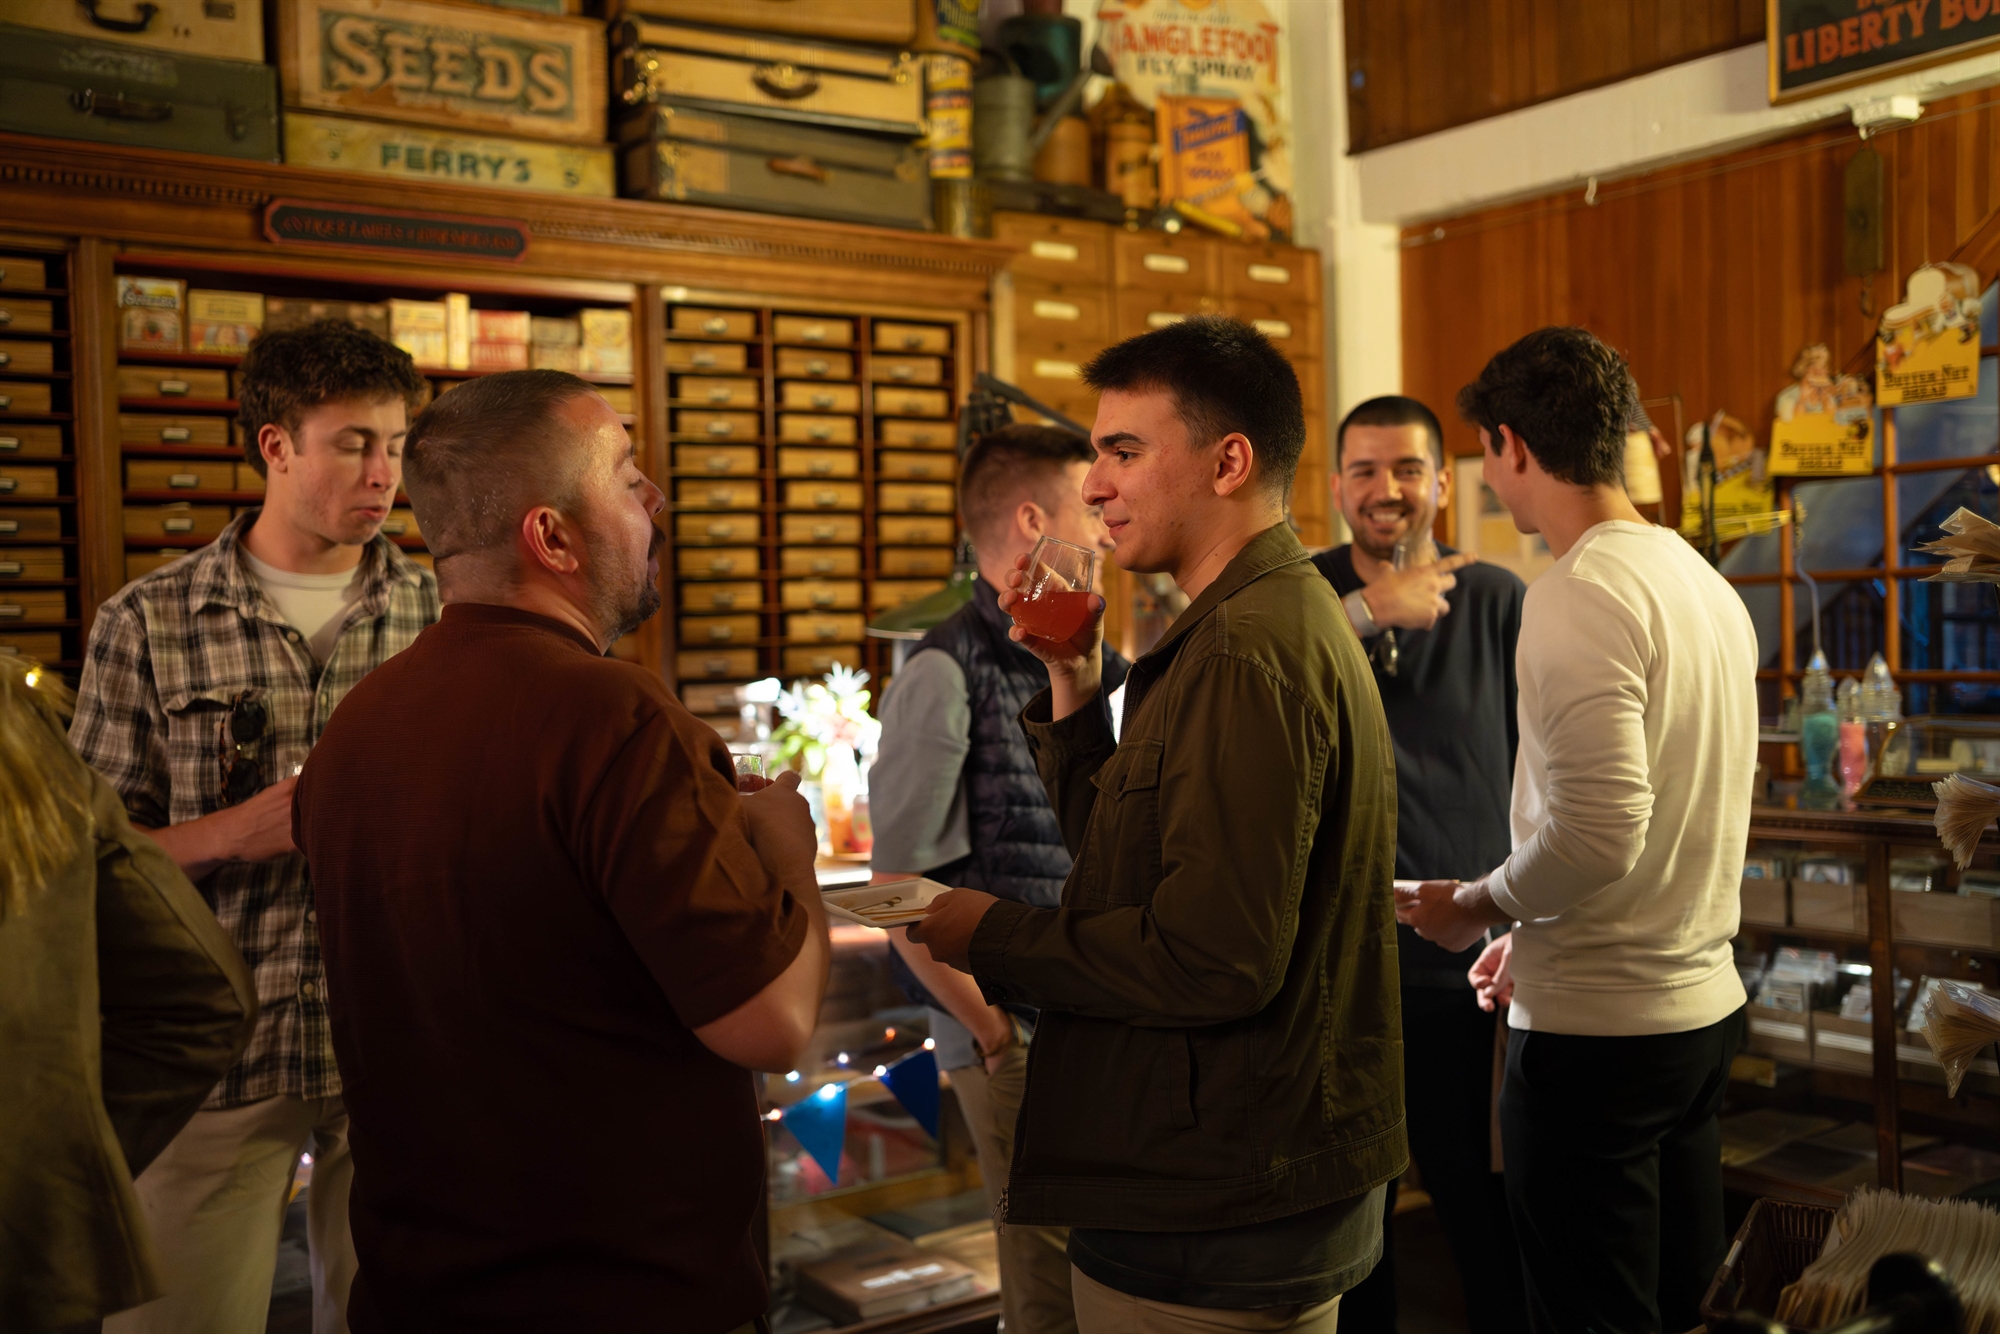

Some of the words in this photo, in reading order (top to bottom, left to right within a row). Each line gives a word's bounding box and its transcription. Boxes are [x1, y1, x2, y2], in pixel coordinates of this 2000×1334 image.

[329, 17, 569, 111] SEEDS
[1096, 11, 1280, 85] TANGLEFOOT
[1784, 0, 1931, 73] LIBERTY
